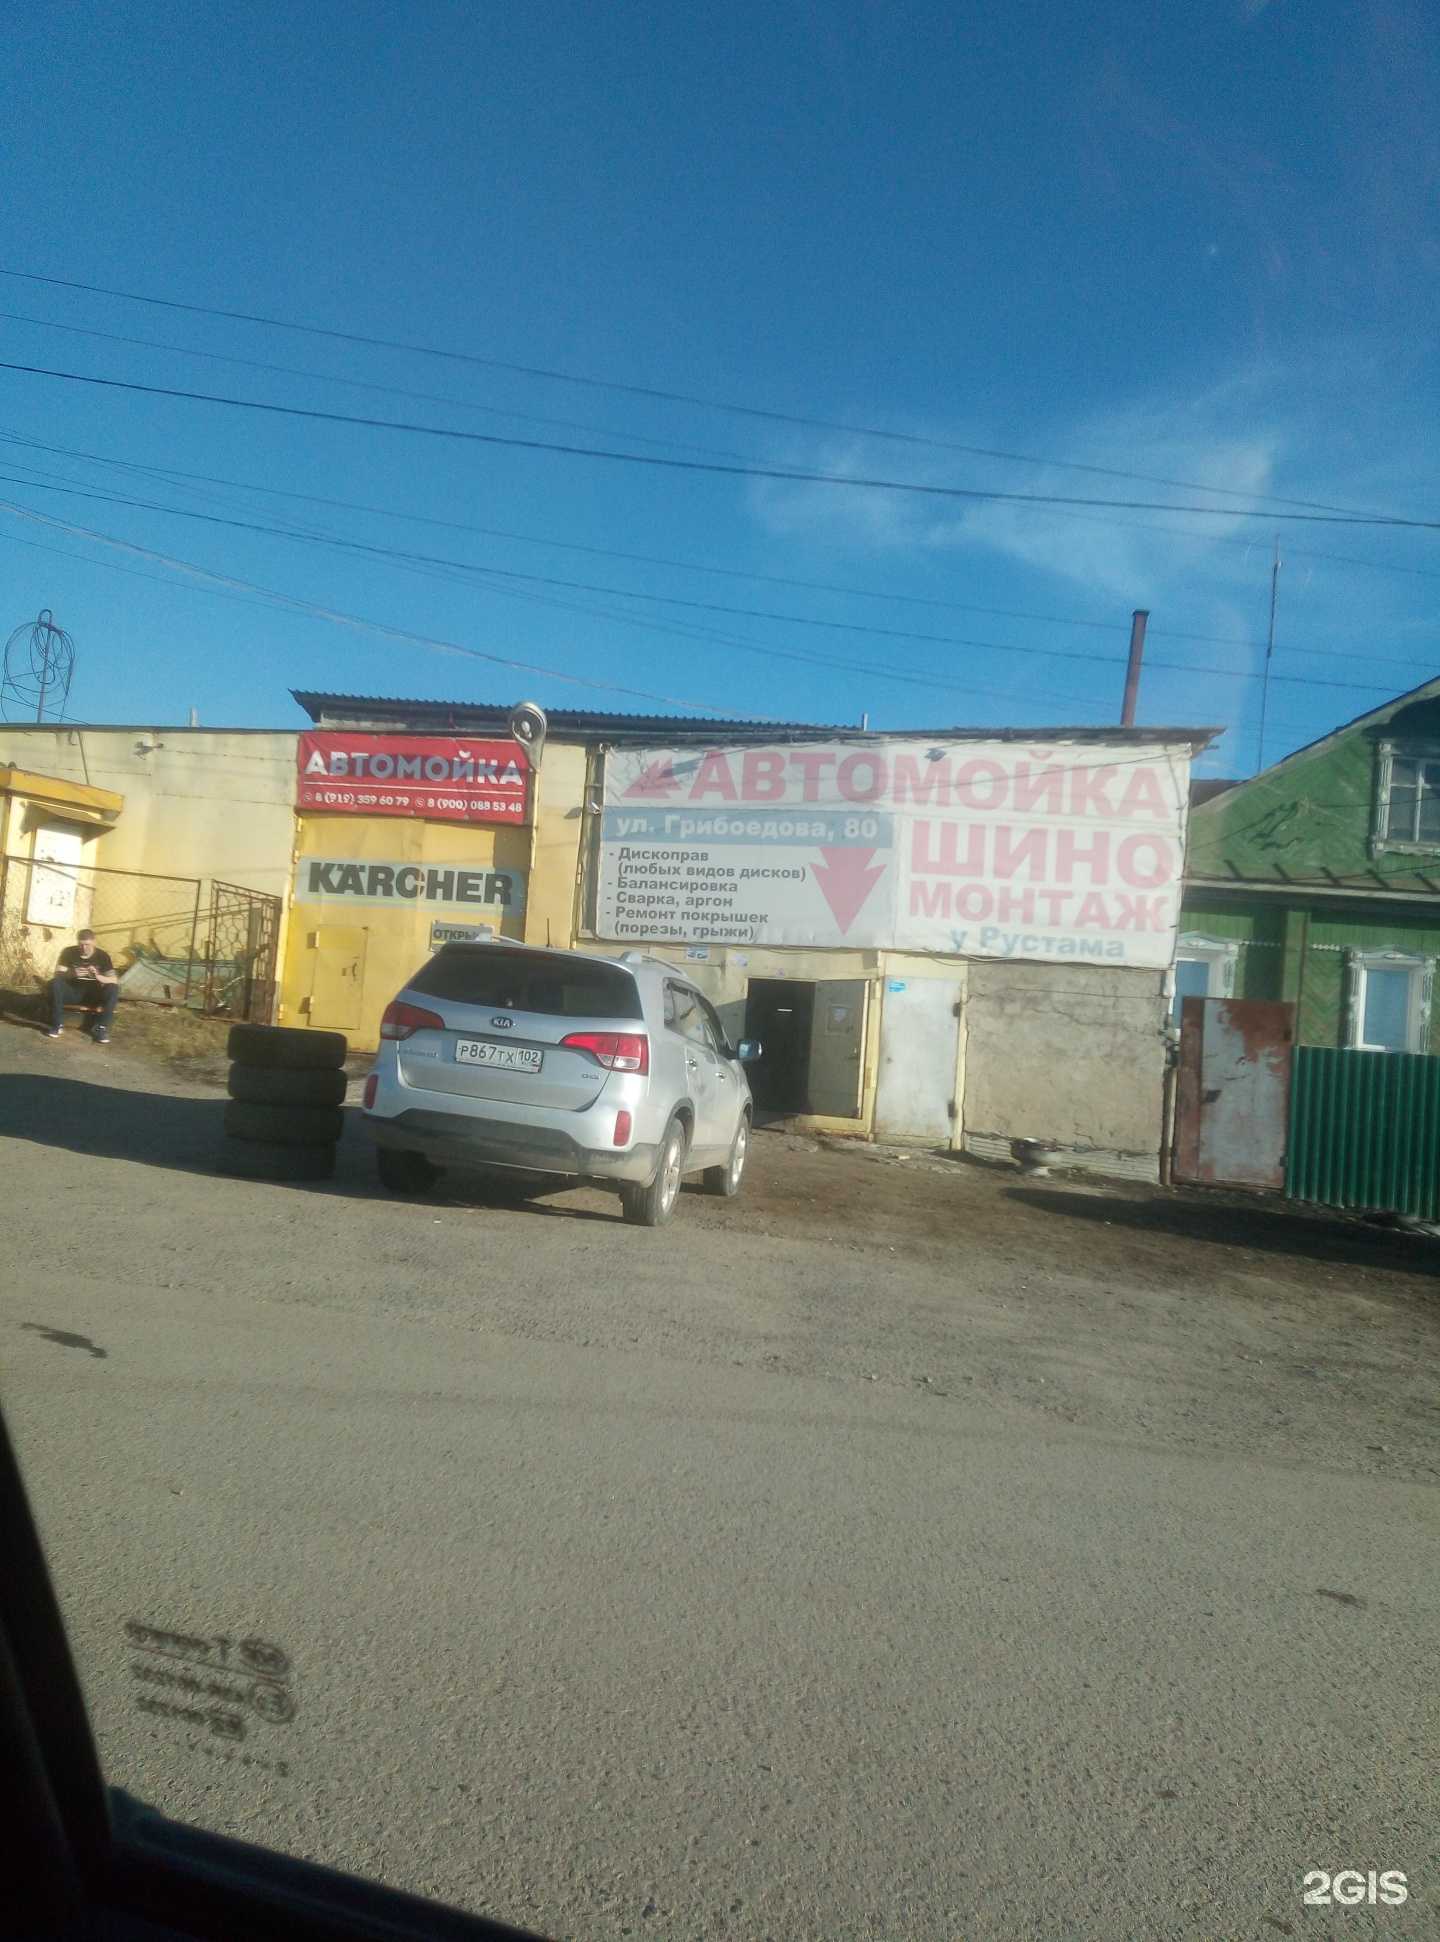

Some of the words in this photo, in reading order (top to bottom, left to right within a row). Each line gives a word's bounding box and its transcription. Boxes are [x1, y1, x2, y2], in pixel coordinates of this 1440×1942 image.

[304, 749, 523, 785] АВТОМОЙКА
[687, 748, 1169, 818] АВТОМОЙКА
[379, 795, 394, 805] 60
[395, 796, 410, 806] 79
[427, 798, 435, 808] 8
[437, 798, 468, 811] (900)
[507, 803, 522, 812] 48
[616, 817, 654, 838] ул.
[664, 815, 834, 841] Грибоедова,
[844, 819, 877, 839] 80
[618, 847, 709, 863] Дископрав
[911, 819, 1174, 889] ШИНО
[618, 862, 681, 877] (любых
[686, 866, 735, 878] видов
[739, 867, 806, 882] дисков)
[308, 862, 513, 905] KÄRCHER
[617, 877, 738, 893] Балансировка
[616, 891, 680, 907] Сварка,
[685, 896, 733, 908] аргон
[909, 880, 1169, 932] МОНТАЖ
[615, 906, 676, 920] Ремонт
[681, 911, 768, 924] покрышек
[614, 920, 688, 937] (порезы,
[692, 926, 754, 940] грыжи)
[980, 926, 1126, 958] Рустама
[493, 1018, 510, 1028] KIA
[518, 1050, 538, 1063] 102
